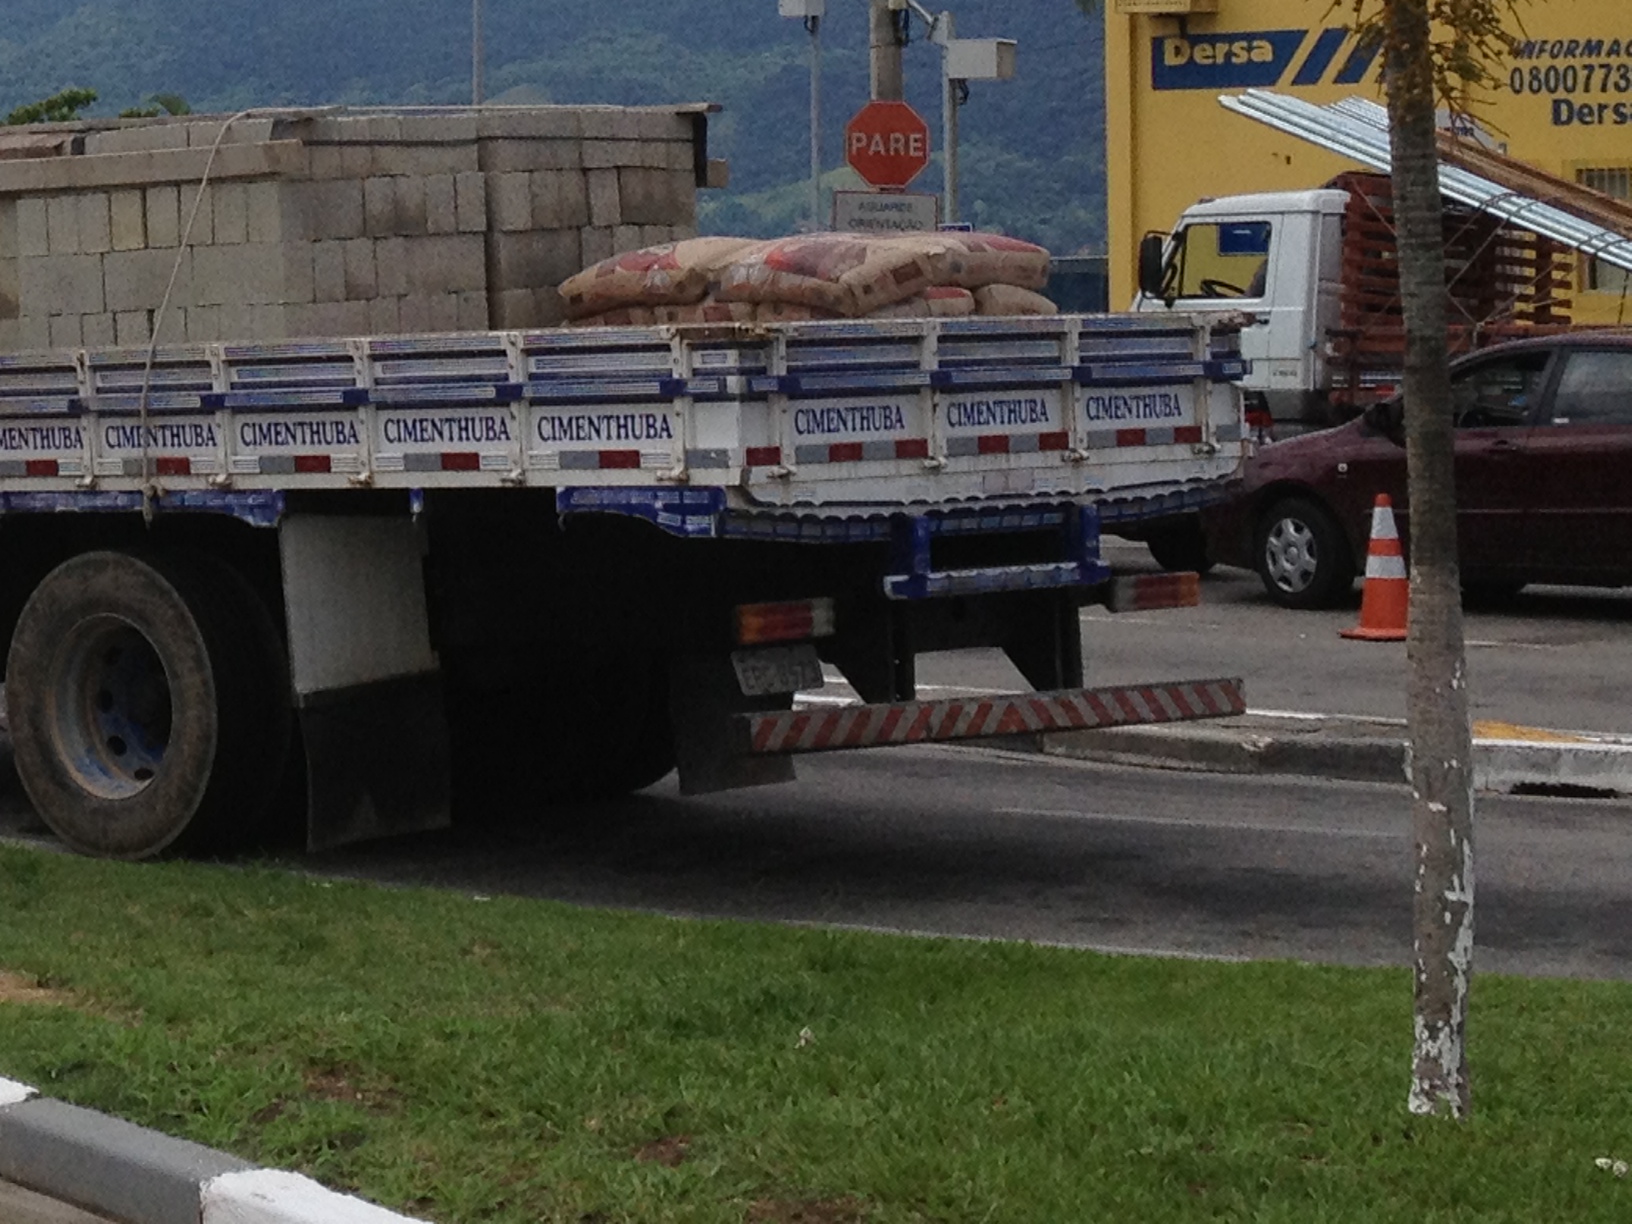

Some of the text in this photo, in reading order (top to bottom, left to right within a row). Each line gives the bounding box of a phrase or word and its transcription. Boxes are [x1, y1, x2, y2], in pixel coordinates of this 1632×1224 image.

[1164, 38, 1273, 66] Dersa
[1551, 97, 1632, 126] Ders
[851, 131, 924, 158] PARE
[794, 405, 906, 436] CIMENTHUBA
[946, 397, 1050, 428] CIMENTHUBA
[1087, 393, 1183, 421] CIMENTHUBA
[240, 419, 360, 447] CIMENTHUBA
[384, 416, 512, 443] CIMENTHUBA
[537, 413, 674, 442] CIMENTHUBA
